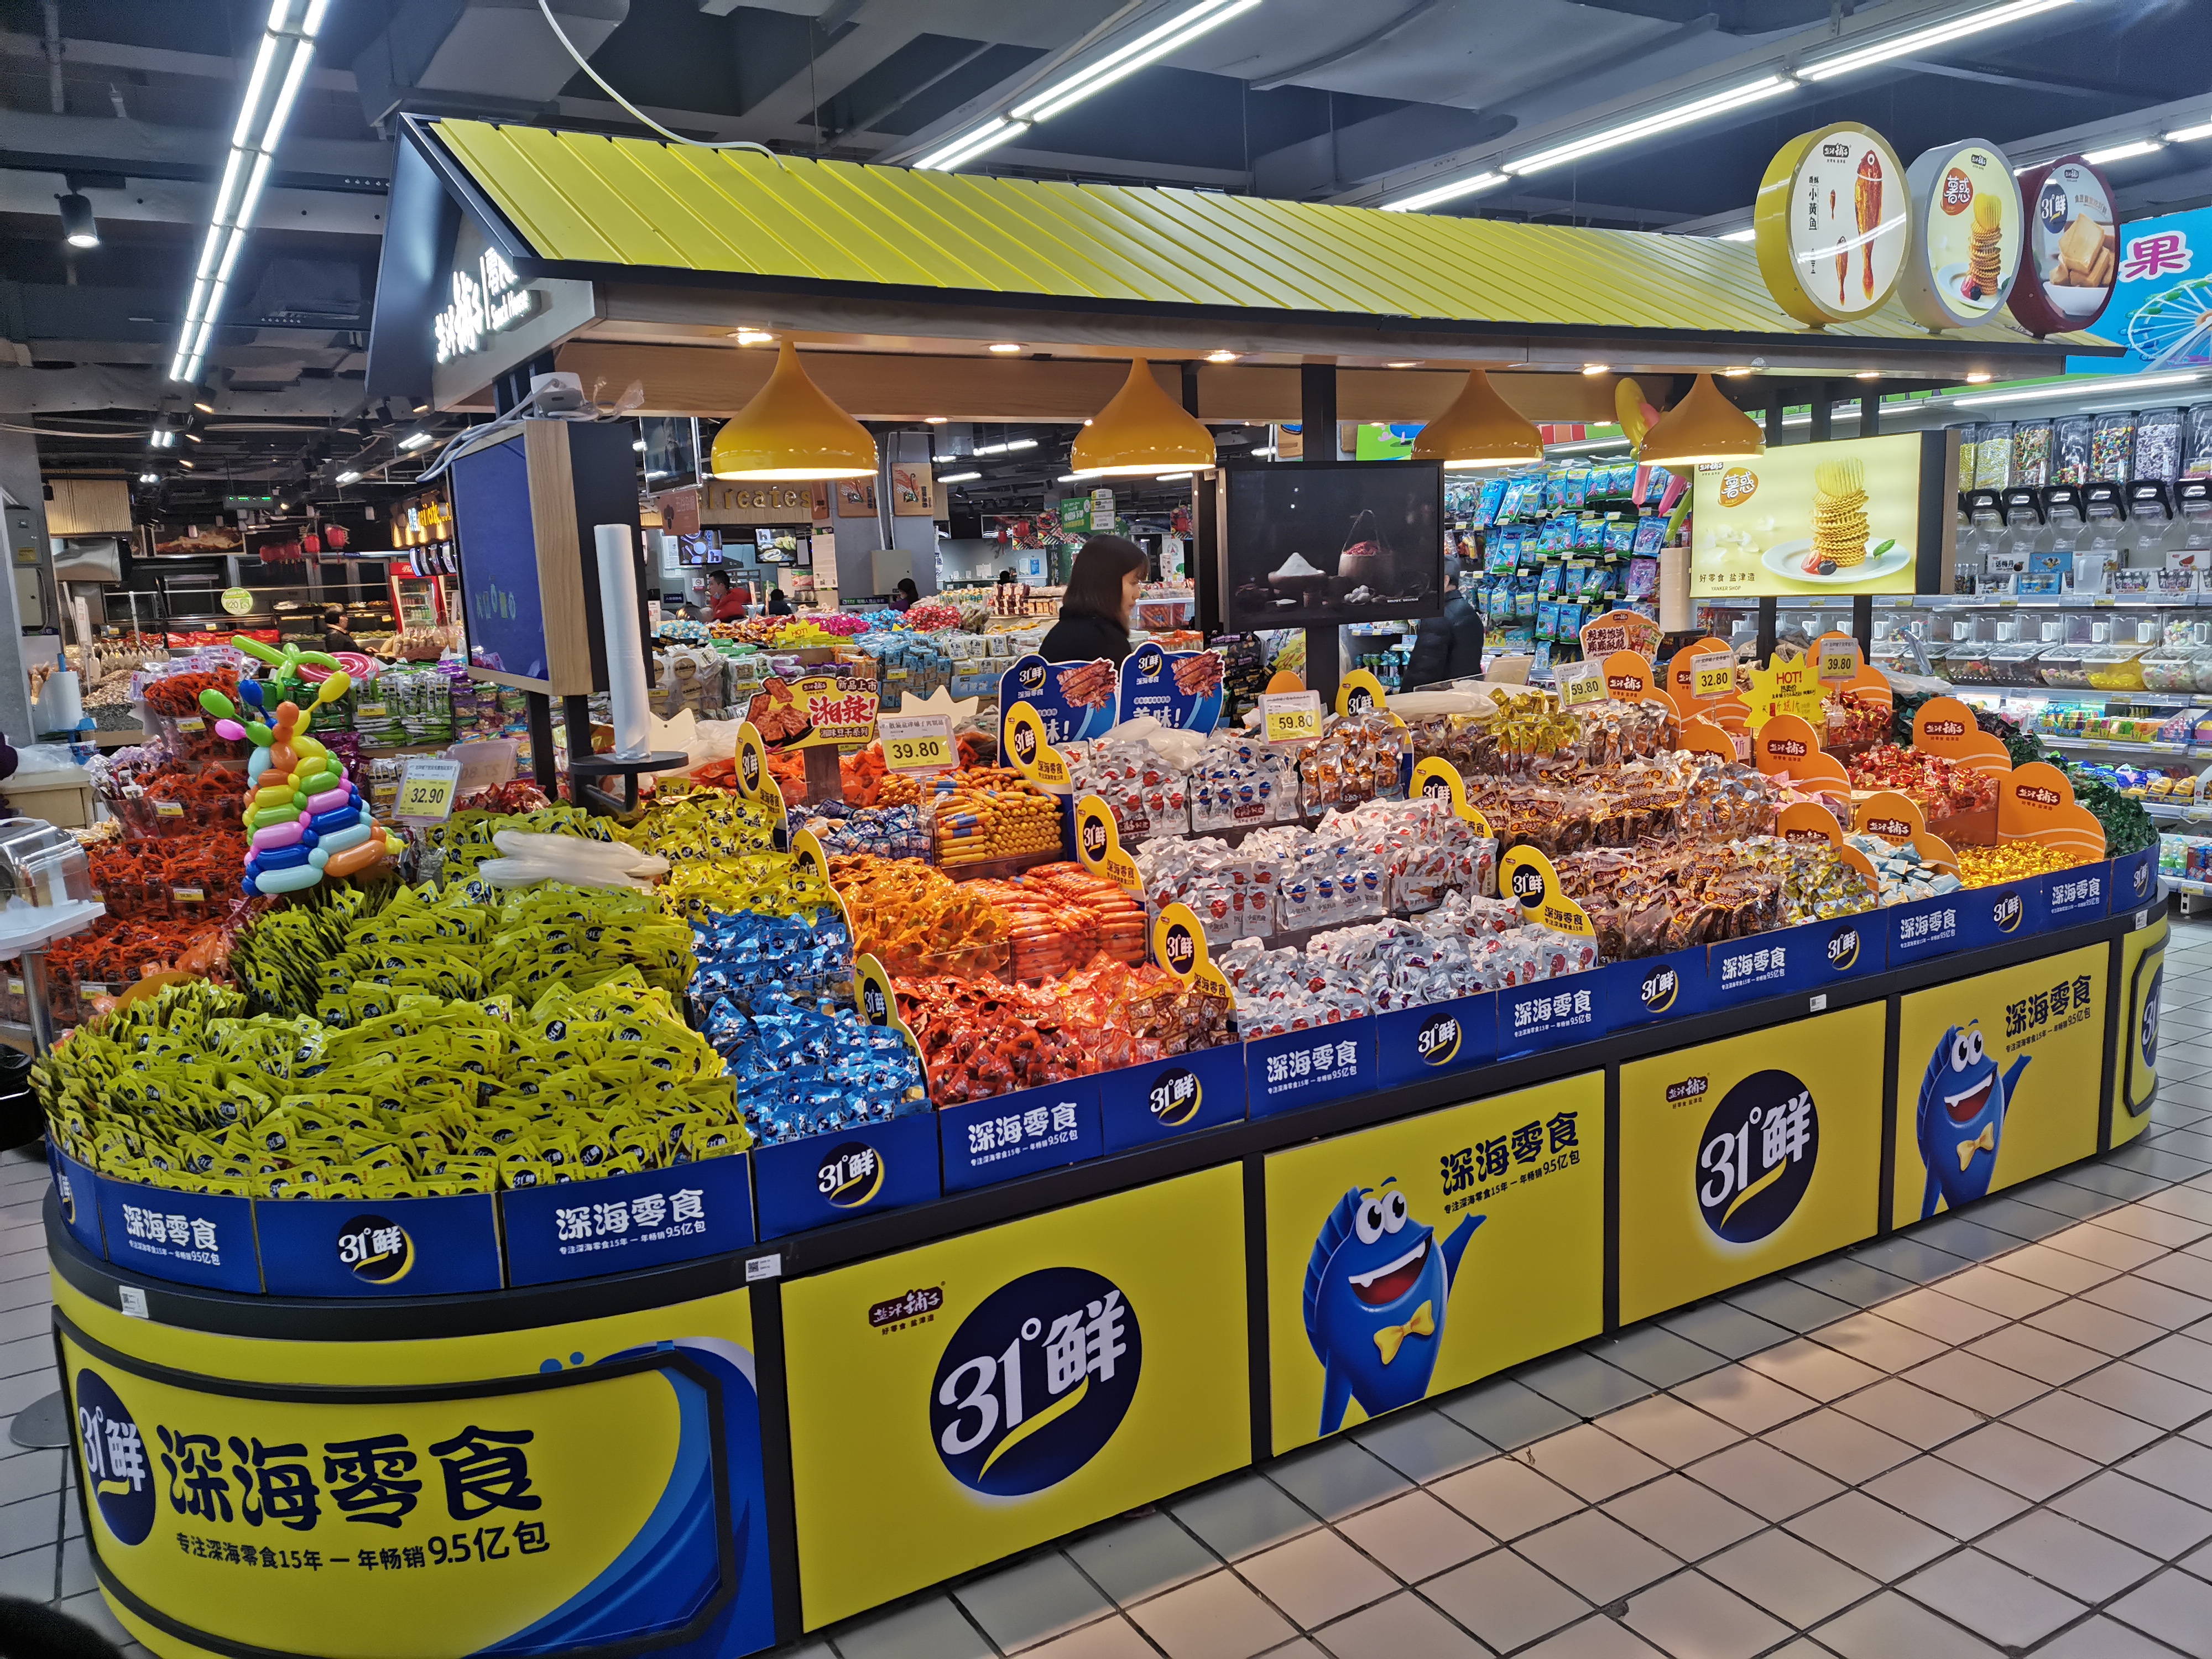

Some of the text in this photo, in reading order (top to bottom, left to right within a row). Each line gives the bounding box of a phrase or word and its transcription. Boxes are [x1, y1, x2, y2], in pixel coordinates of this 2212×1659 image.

[1944, 175, 1970, 204] 薯惑
[2124, 235, 2186, 278] 果
[1721, 471, 1755, 499] 薯惑
[1699, 572, 1755, 582] 好零食 盐津造
[1587, 627, 1625, 641] 粒粒饱满
[1776, 671, 1802, 685] HOT!
[1828, 658, 1851, 670] 39.80
[837, 679, 878, 691] 新品上市
[1571, 680, 1599, 696] 59.80
[1702, 672, 1728, 687] 32.80
[808, 695, 875, 726] 湘辣!
[1279, 715, 1313, 729] 59.80
[820, 727, 869, 738] 湘味豆干系列
[892, 742, 939, 759] 39.80
[411, 787, 444, 804] 32.90
[2052, 877, 2101, 906] 深海零食
[1545, 906, 1583, 926] 深海零食
[1901, 908, 1957, 941] 深海零食
[1721, 947, 1786, 981] 深海零食
[1514, 989, 1592, 1027] 深海零食
[2006, 974, 2091, 1037] 深海零食
[1266, 1040, 1358, 1083] 深海零食
[968, 1102, 1078, 1154] 深海零食
[1439, 1111, 1579, 1196] 深海零食
[122, 1203, 219, 1251] 深海零食
[556, 1188, 705, 1241] 深海零食
[873, 1291, 941, 1323] 盐津铺子
[155, 1425, 542, 1531] 深海零食
